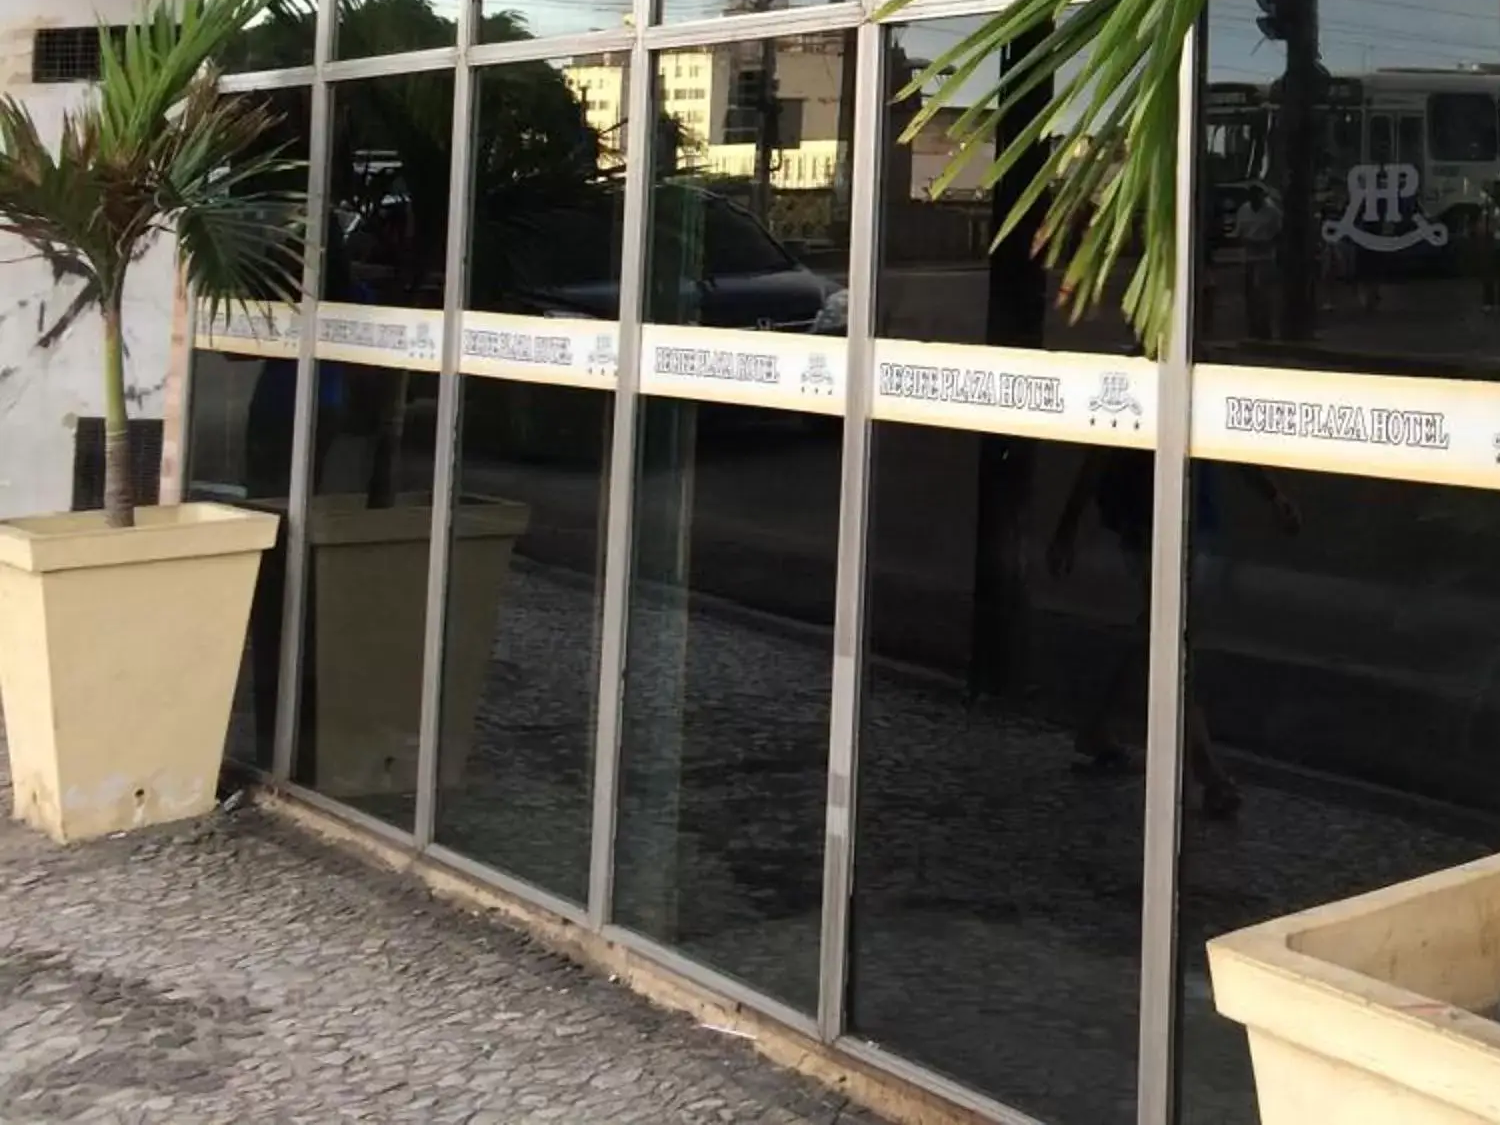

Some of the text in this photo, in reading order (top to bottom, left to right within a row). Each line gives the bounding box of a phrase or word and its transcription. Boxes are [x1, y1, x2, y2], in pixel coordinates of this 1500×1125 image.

[880, 362, 939, 400] RECIFE
[941, 367, 997, 405] PLAZA
[999, 373, 1064, 413] HOTEL
[1226, 396, 1449, 449] RECIFE PLAZA HOTEL
